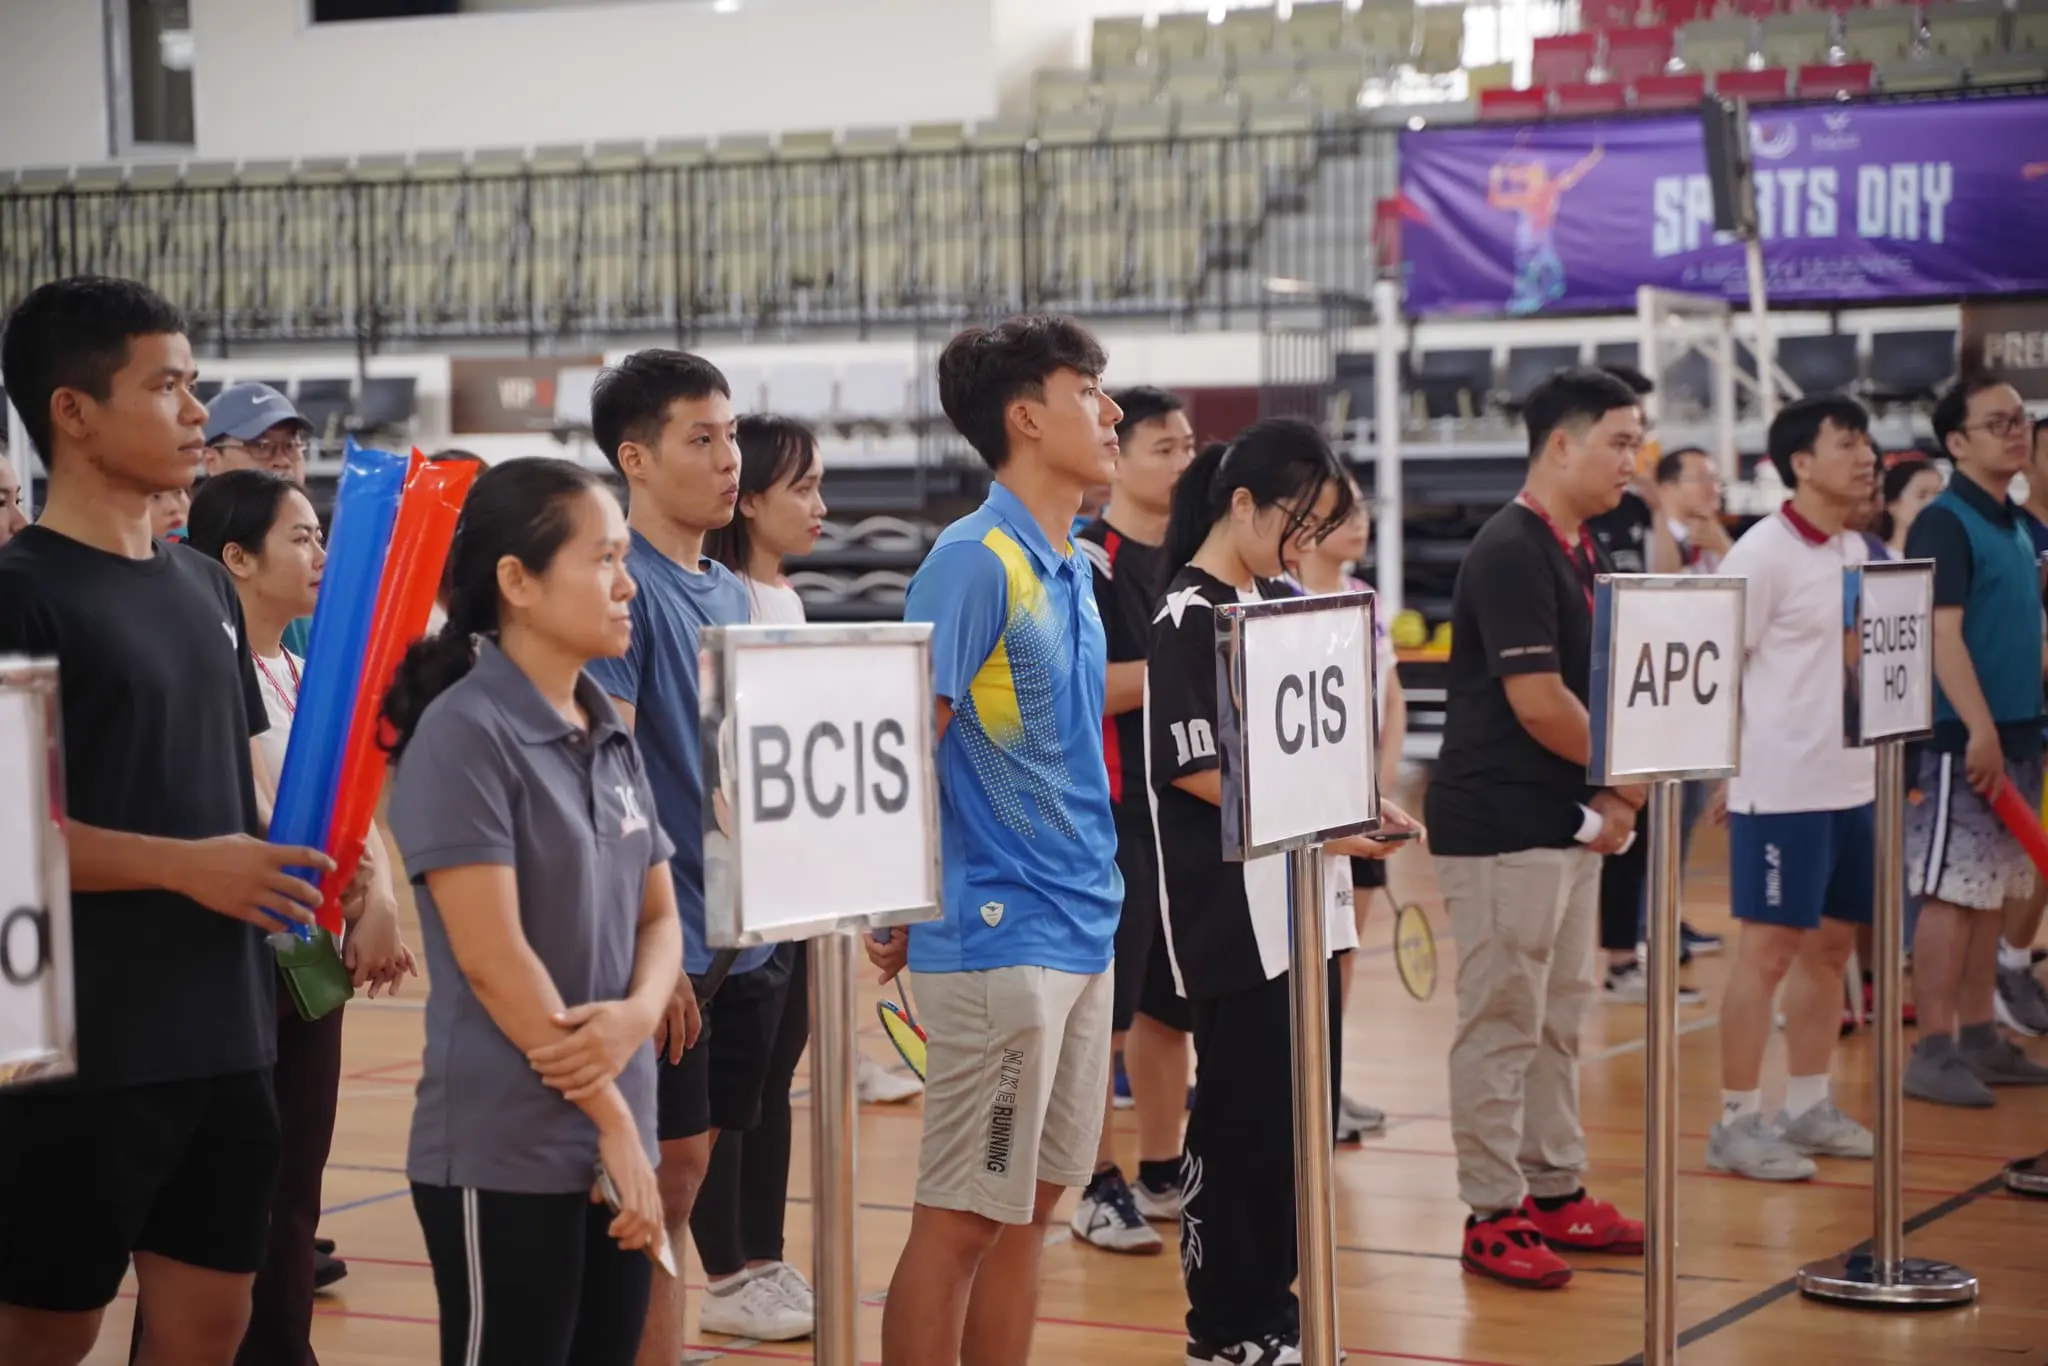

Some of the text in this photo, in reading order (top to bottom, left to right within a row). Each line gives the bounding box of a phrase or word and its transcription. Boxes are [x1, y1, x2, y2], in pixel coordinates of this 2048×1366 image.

[1653, 161, 1953, 257] SPRTS DAY
[1983, 330, 2048, 370] PRE
[1862, 613, 1925, 655] EQUEST
[1627, 640, 1719, 708] APC
[1884, 664, 1907, 702] HO
[1170, 718, 1217, 767] 10
[1275, 664, 1347, 755] CIS
[749, 718, 909, 823] BCIS
[986, 1048, 1024, 1173] NIKE RUNNING
